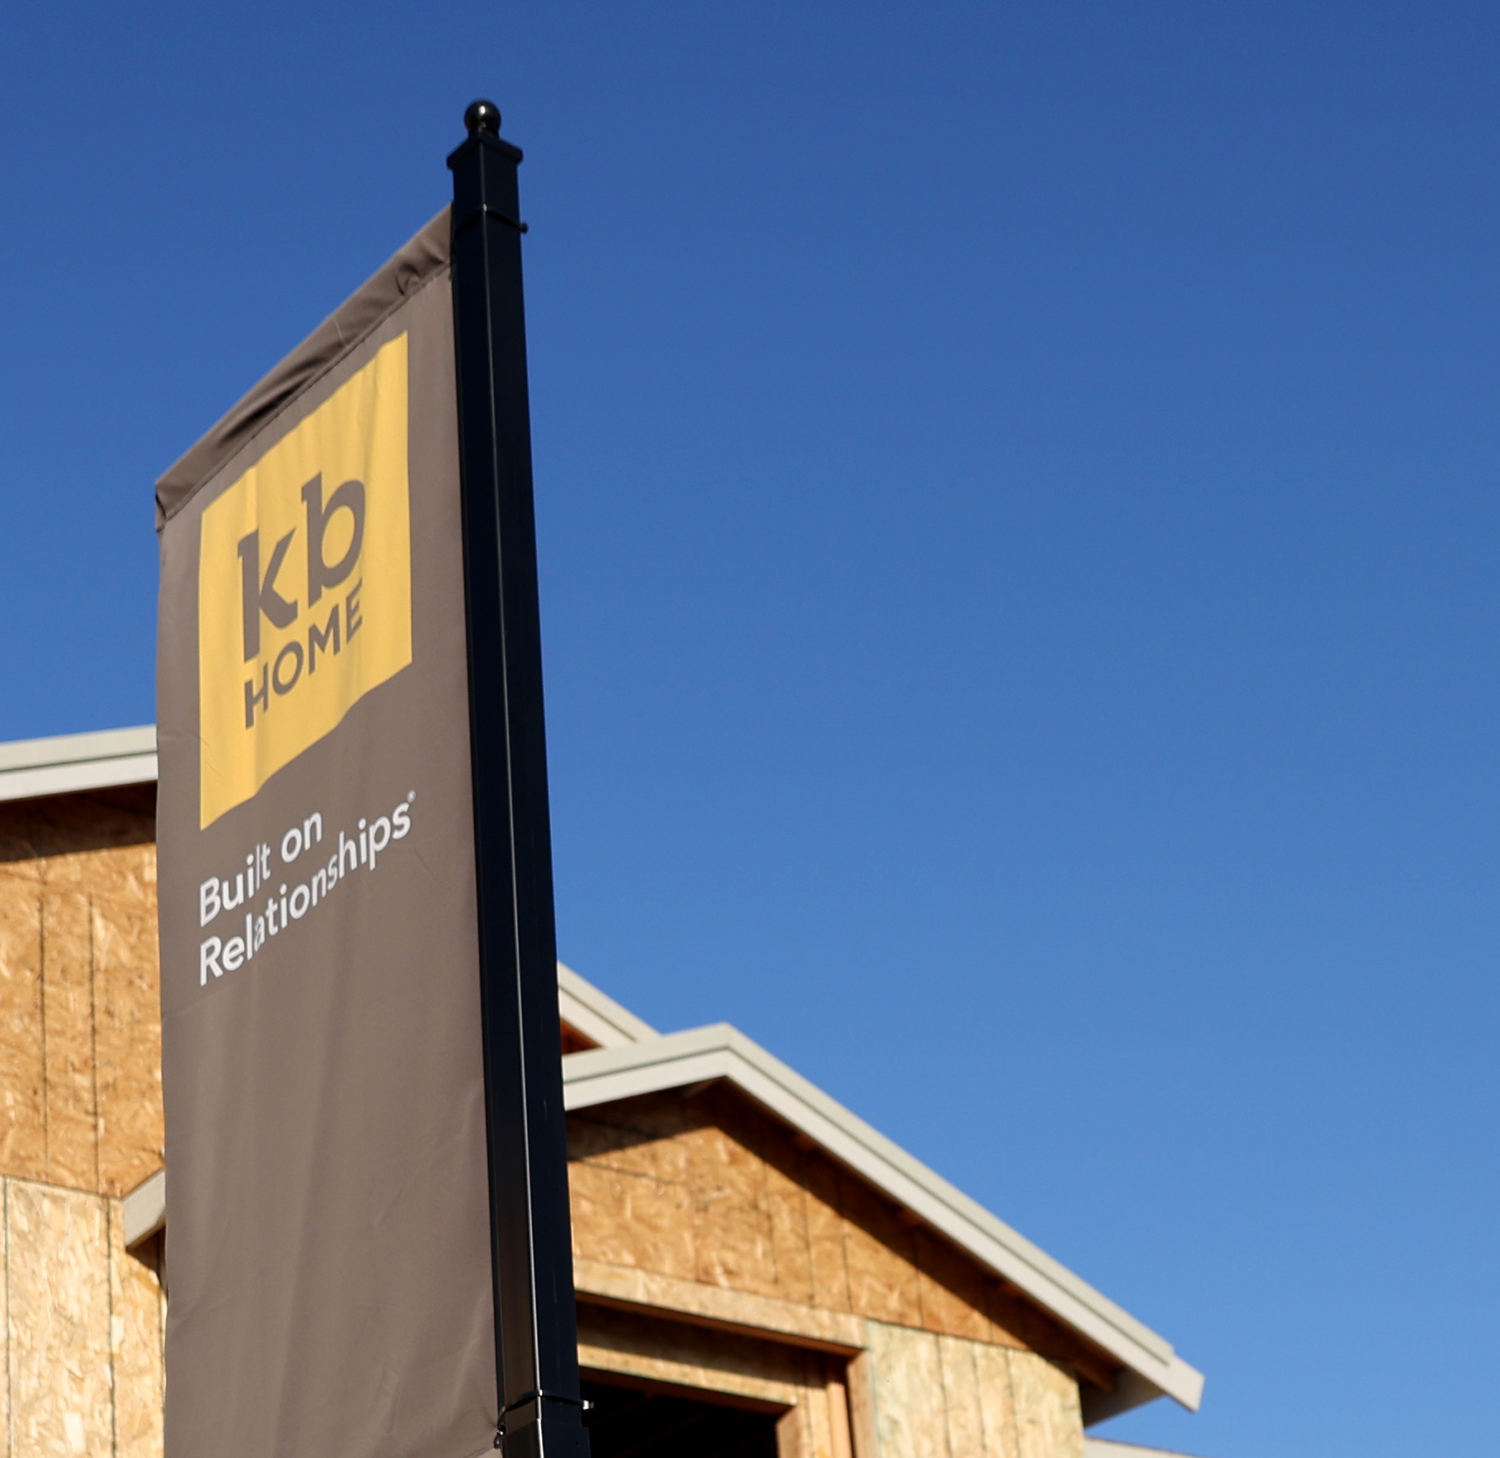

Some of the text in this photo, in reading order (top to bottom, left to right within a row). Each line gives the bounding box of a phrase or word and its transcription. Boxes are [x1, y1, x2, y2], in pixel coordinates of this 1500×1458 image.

[238, 471, 366, 662] kb
[244, 577, 363, 730] HOME
[200, 811, 323, 928] Built on
